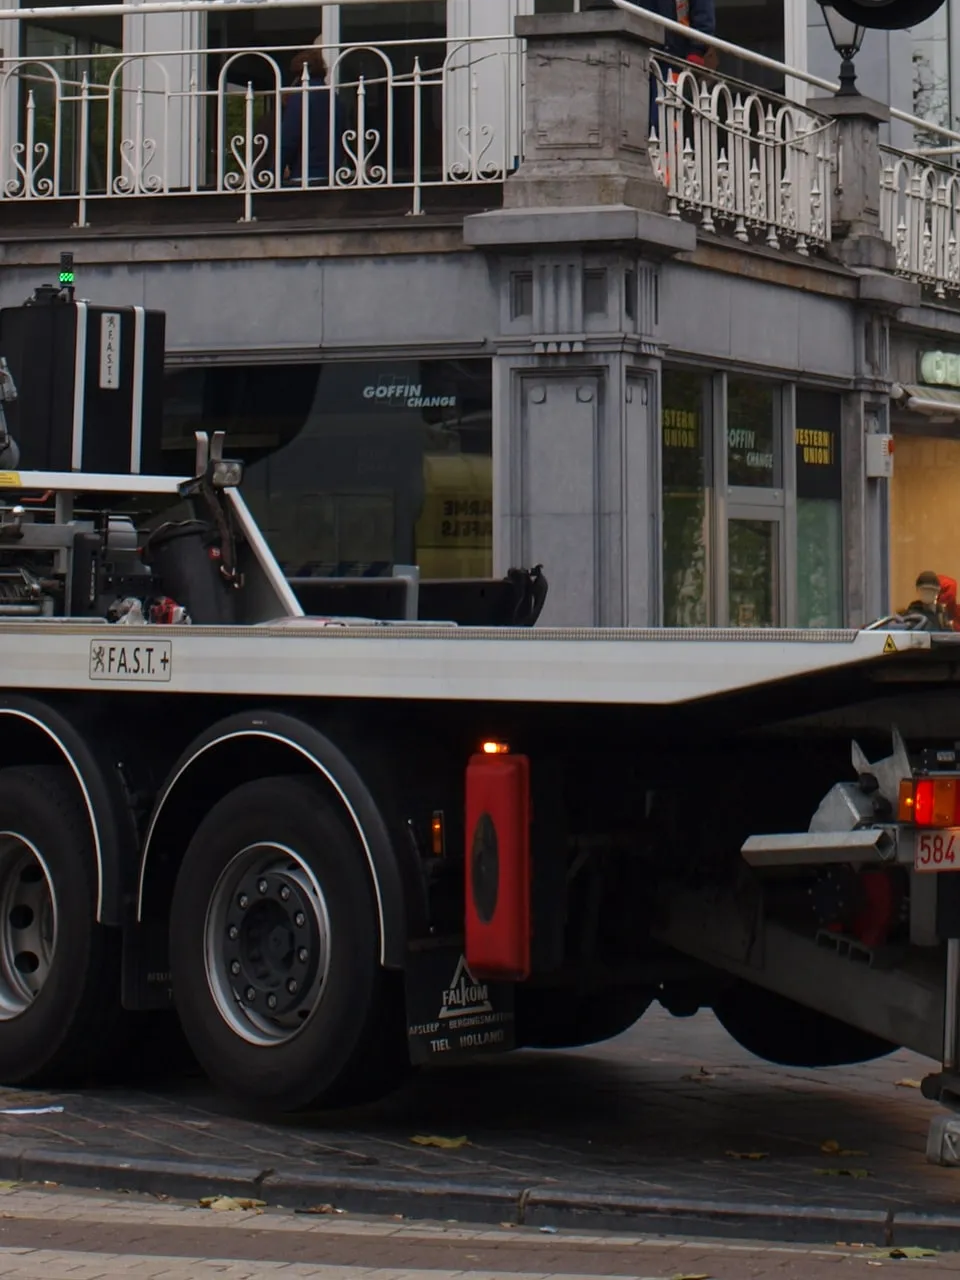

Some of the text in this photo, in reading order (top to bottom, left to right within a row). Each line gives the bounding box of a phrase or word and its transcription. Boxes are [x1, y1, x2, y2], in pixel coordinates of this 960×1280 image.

[362, 384, 422, 398] GOFFIN
[407, 396, 457, 408] CHANGE
[664, 428, 697, 448] UNION
[746, 451, 774, 469] CHANGE
[803, 447, 831, 465] UNION
[442, 976, 489, 1007] FALKOM
[430, 1029, 504, 1052] TIEL HOLLAND
